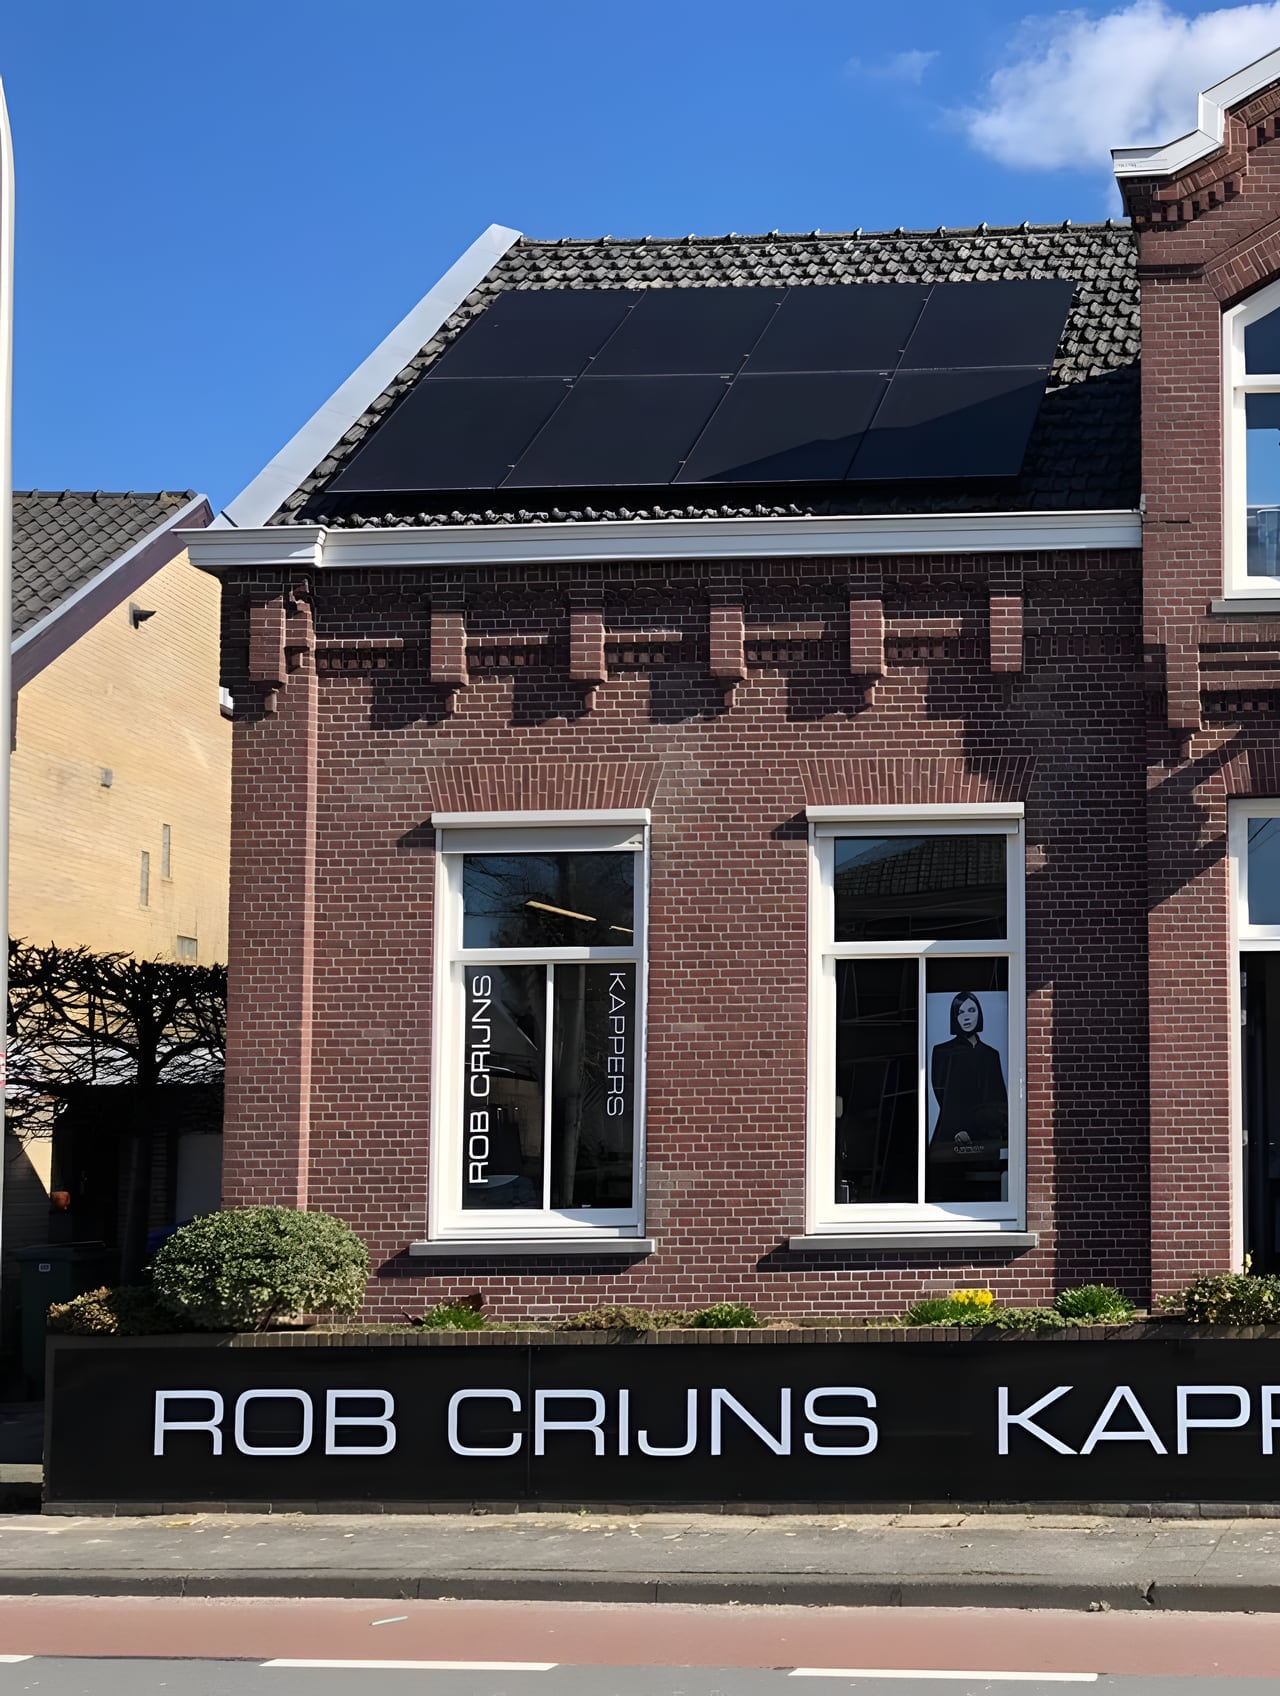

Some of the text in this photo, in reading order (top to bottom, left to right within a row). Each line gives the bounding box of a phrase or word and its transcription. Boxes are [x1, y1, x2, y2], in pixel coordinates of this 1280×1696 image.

[468, 975, 492, 1184] ROB CRIJNS
[606, 972, 626, 1116] KAPPERS
[153, 1388, 397, 1456] ROB
[447, 1386, 879, 1457] CRIJNS
